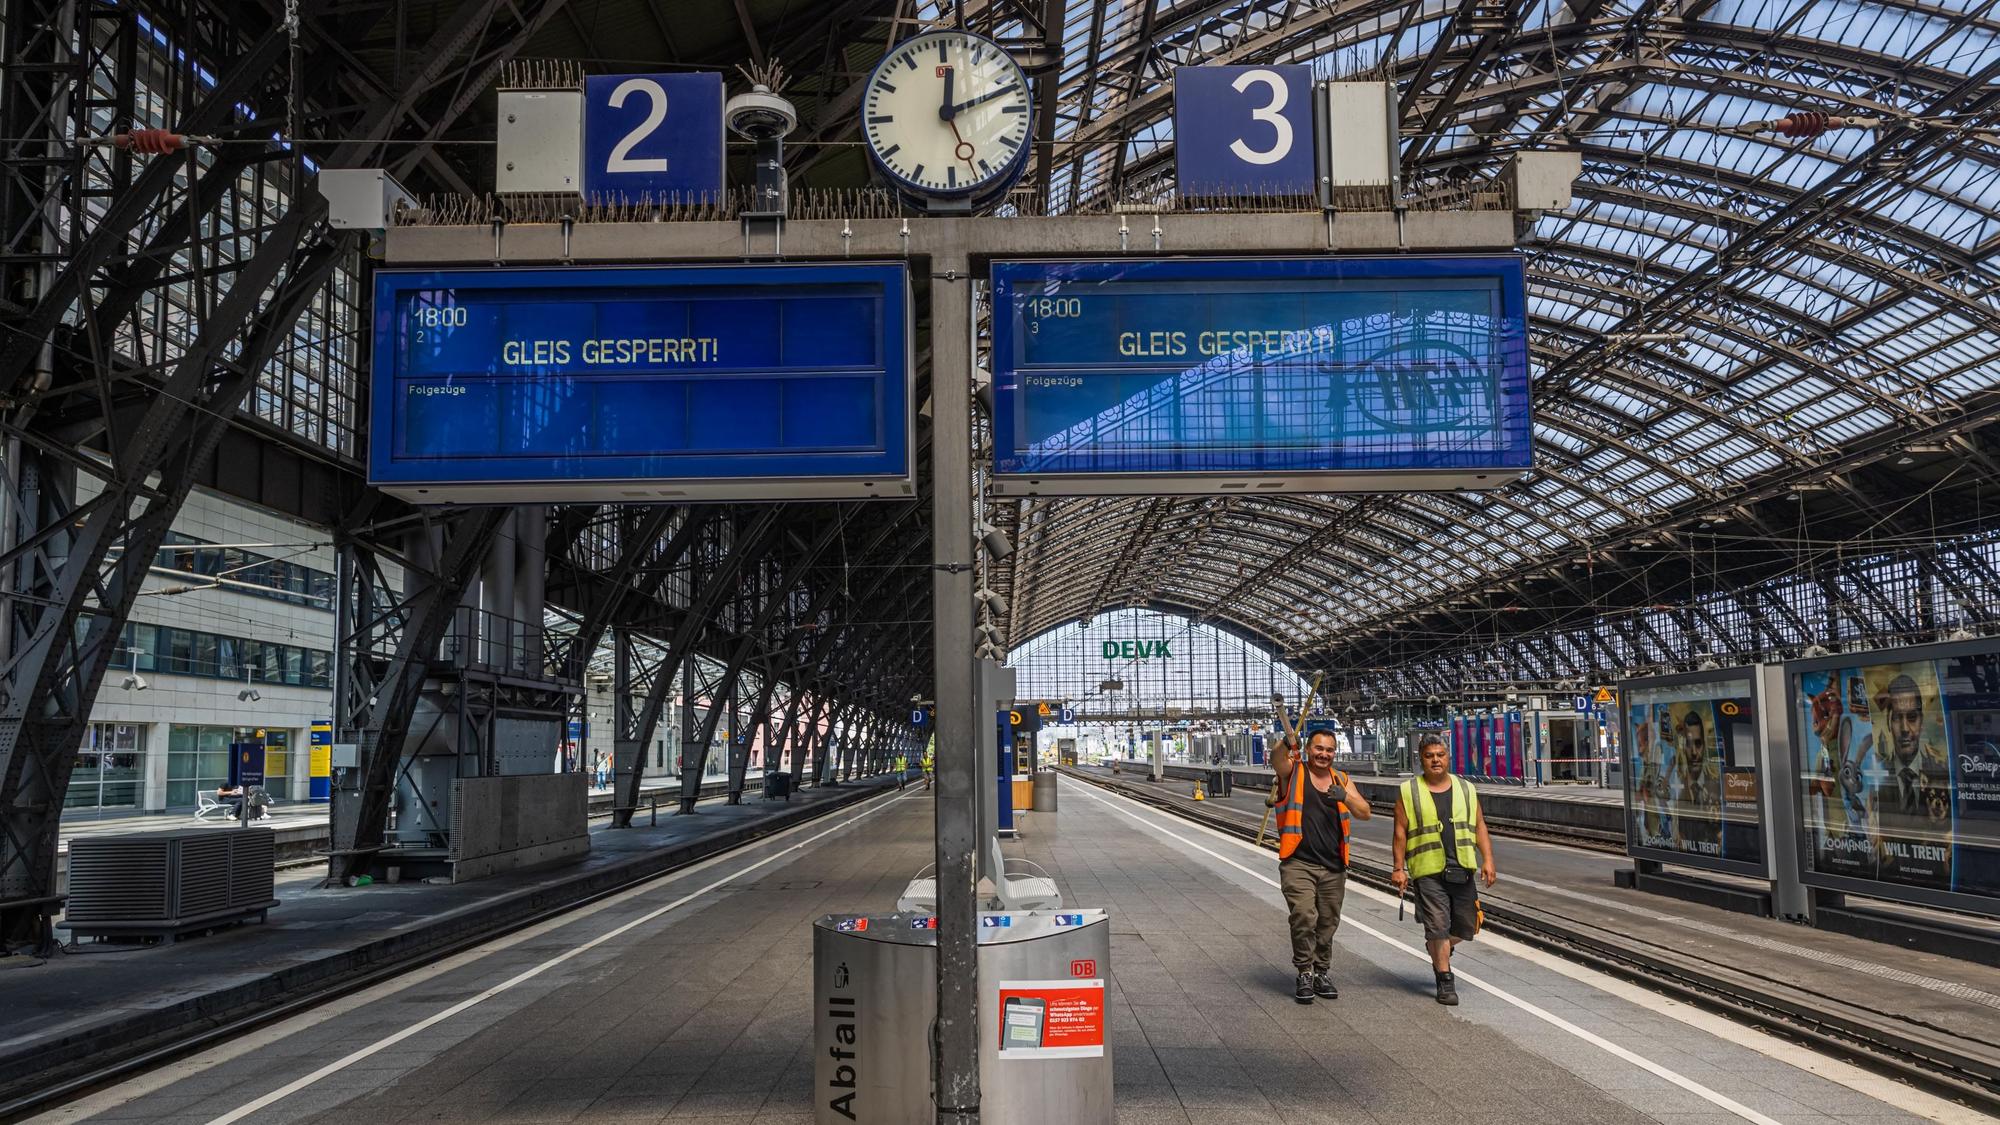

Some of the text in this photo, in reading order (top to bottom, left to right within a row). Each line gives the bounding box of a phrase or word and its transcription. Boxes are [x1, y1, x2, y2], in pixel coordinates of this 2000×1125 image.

[1229, 69, 1294, 165] 3
[607, 78, 667, 173] 2
[1028, 298, 1081, 318] 18:00
[413, 307, 467, 327] 18:00
[1031, 321, 1039, 334] 3
[416, 331, 424, 343] 2
[1119, 330, 1335, 356] GLEIS GESPERRT!
[503, 337, 718, 365] GLEIS GESPERRT!
[1025, 377, 1083, 387] Folgezüge
[408, 385, 467, 396] Folgezüge
[1102, 640, 1172, 659] DEVK
[1577, 697, 1587, 709] D
[912, 711, 922, 723] D
[1063, 709, 1073, 721] D
[1957, 791, 1976, 800] Jetzt
[1681, 839, 1719, 855] WILL TRENT
[1822, 838, 1873, 853] ZOOMANIA
[1883, 841, 1946, 862] WILL TRENT
[1072, 961, 1094, 977] DB
[829, 997, 856, 1122] Abfall
